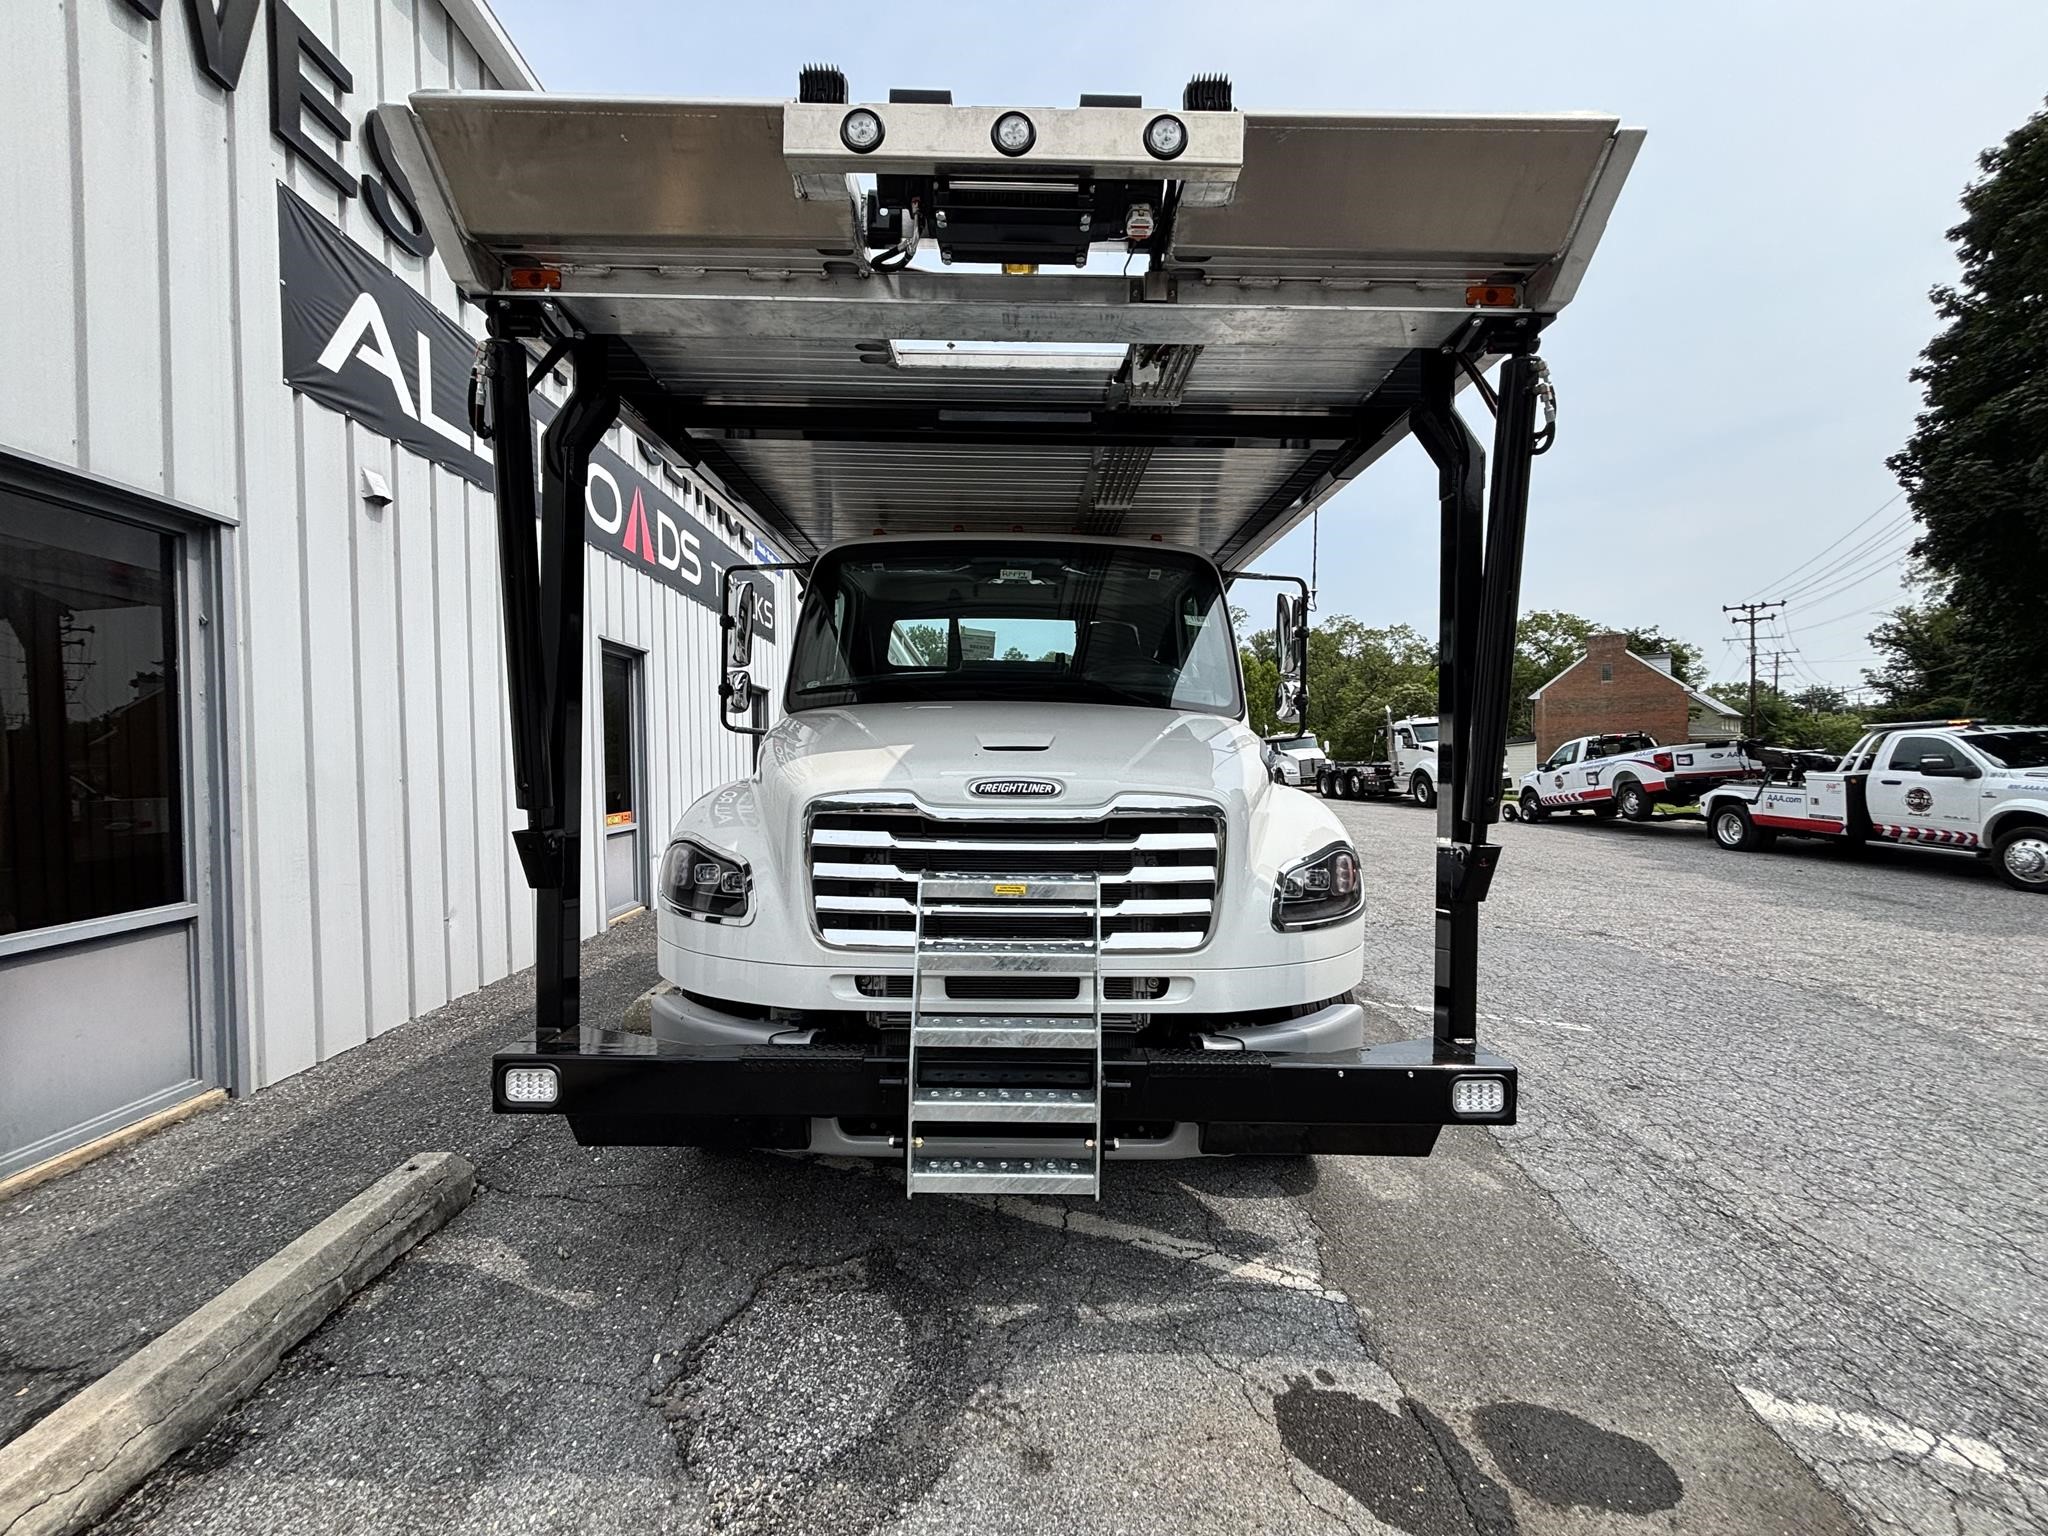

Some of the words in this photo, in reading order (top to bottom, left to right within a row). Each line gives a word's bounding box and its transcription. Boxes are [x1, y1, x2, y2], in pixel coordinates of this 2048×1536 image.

[536, 417, 702, 587] OADS
[978, 782, 1053, 793] FREIGHTLINER
[1767, 794, 1802, 804] AAA.com
